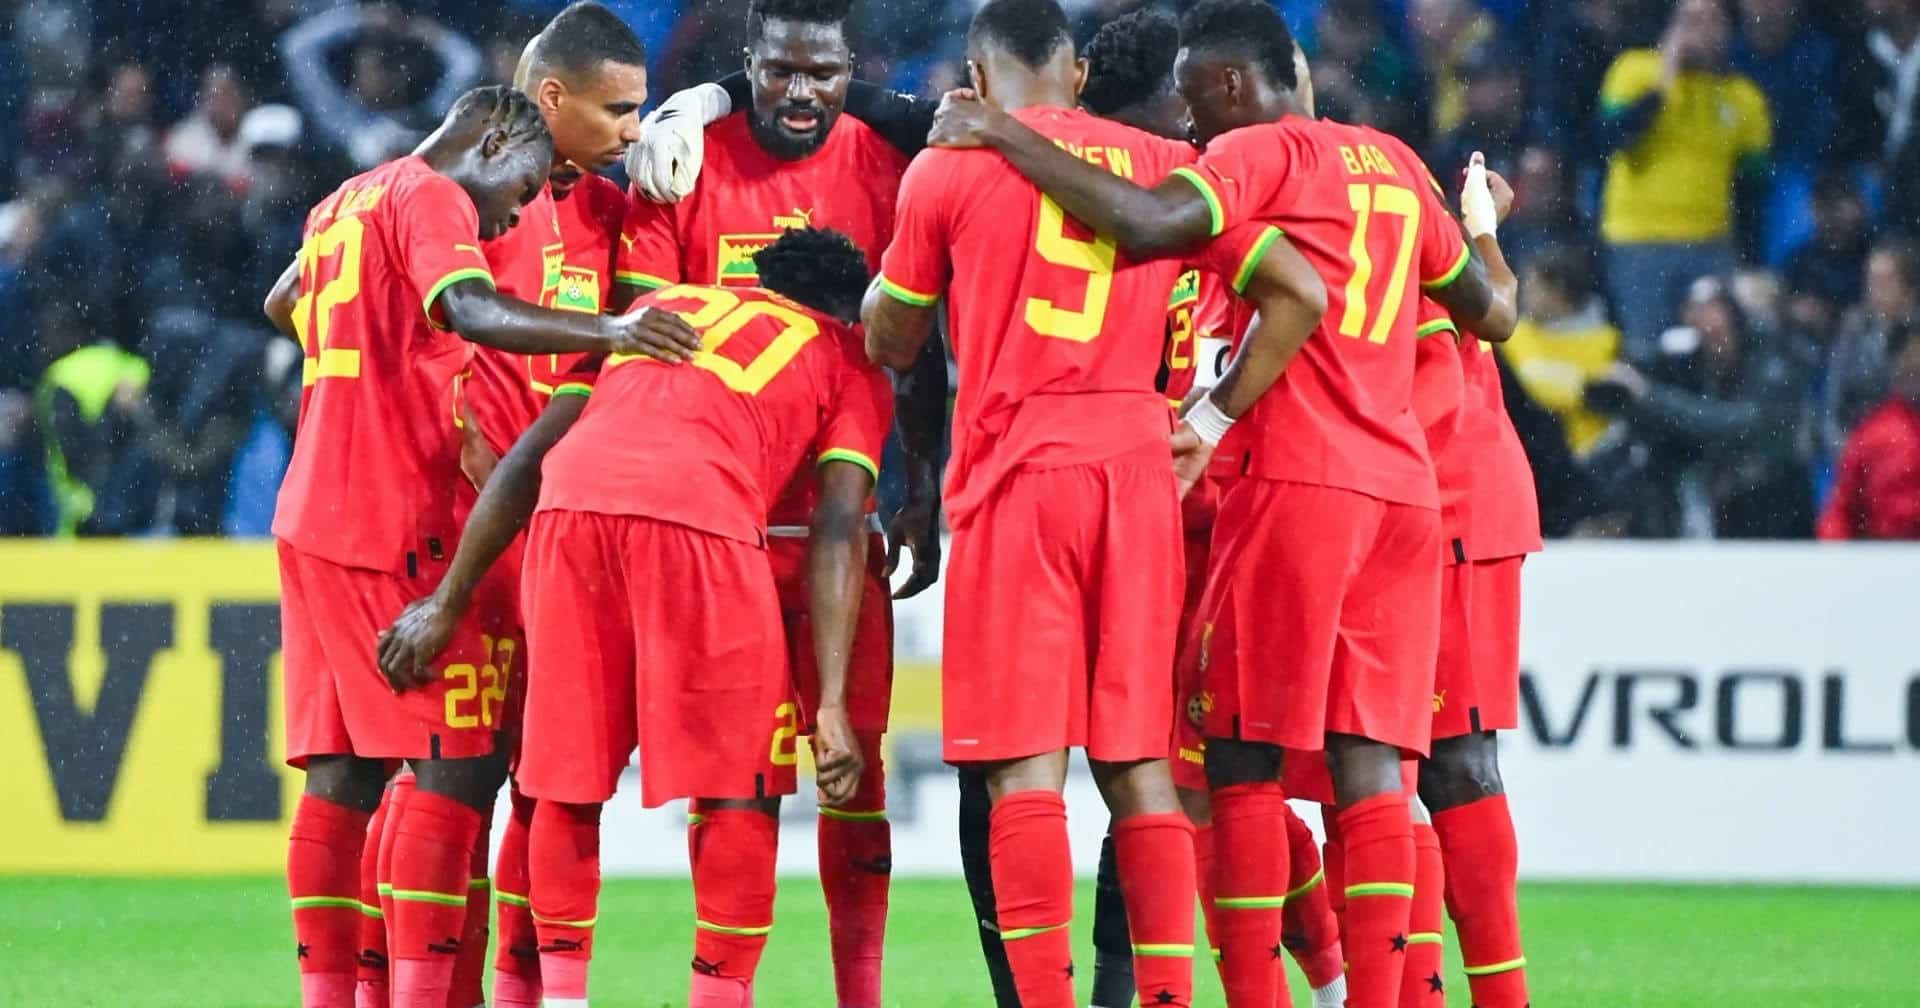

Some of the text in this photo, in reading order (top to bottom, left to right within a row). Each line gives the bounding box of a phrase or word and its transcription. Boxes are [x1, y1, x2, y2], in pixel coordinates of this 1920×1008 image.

[1053, 137, 1133, 177] YEW
[291, 215, 364, 387] 22
[606, 284, 820, 396] 20
[1024, 192, 1117, 344] 9
[1339, 184, 1421, 345] 17
[0, 603, 282, 822] VI
